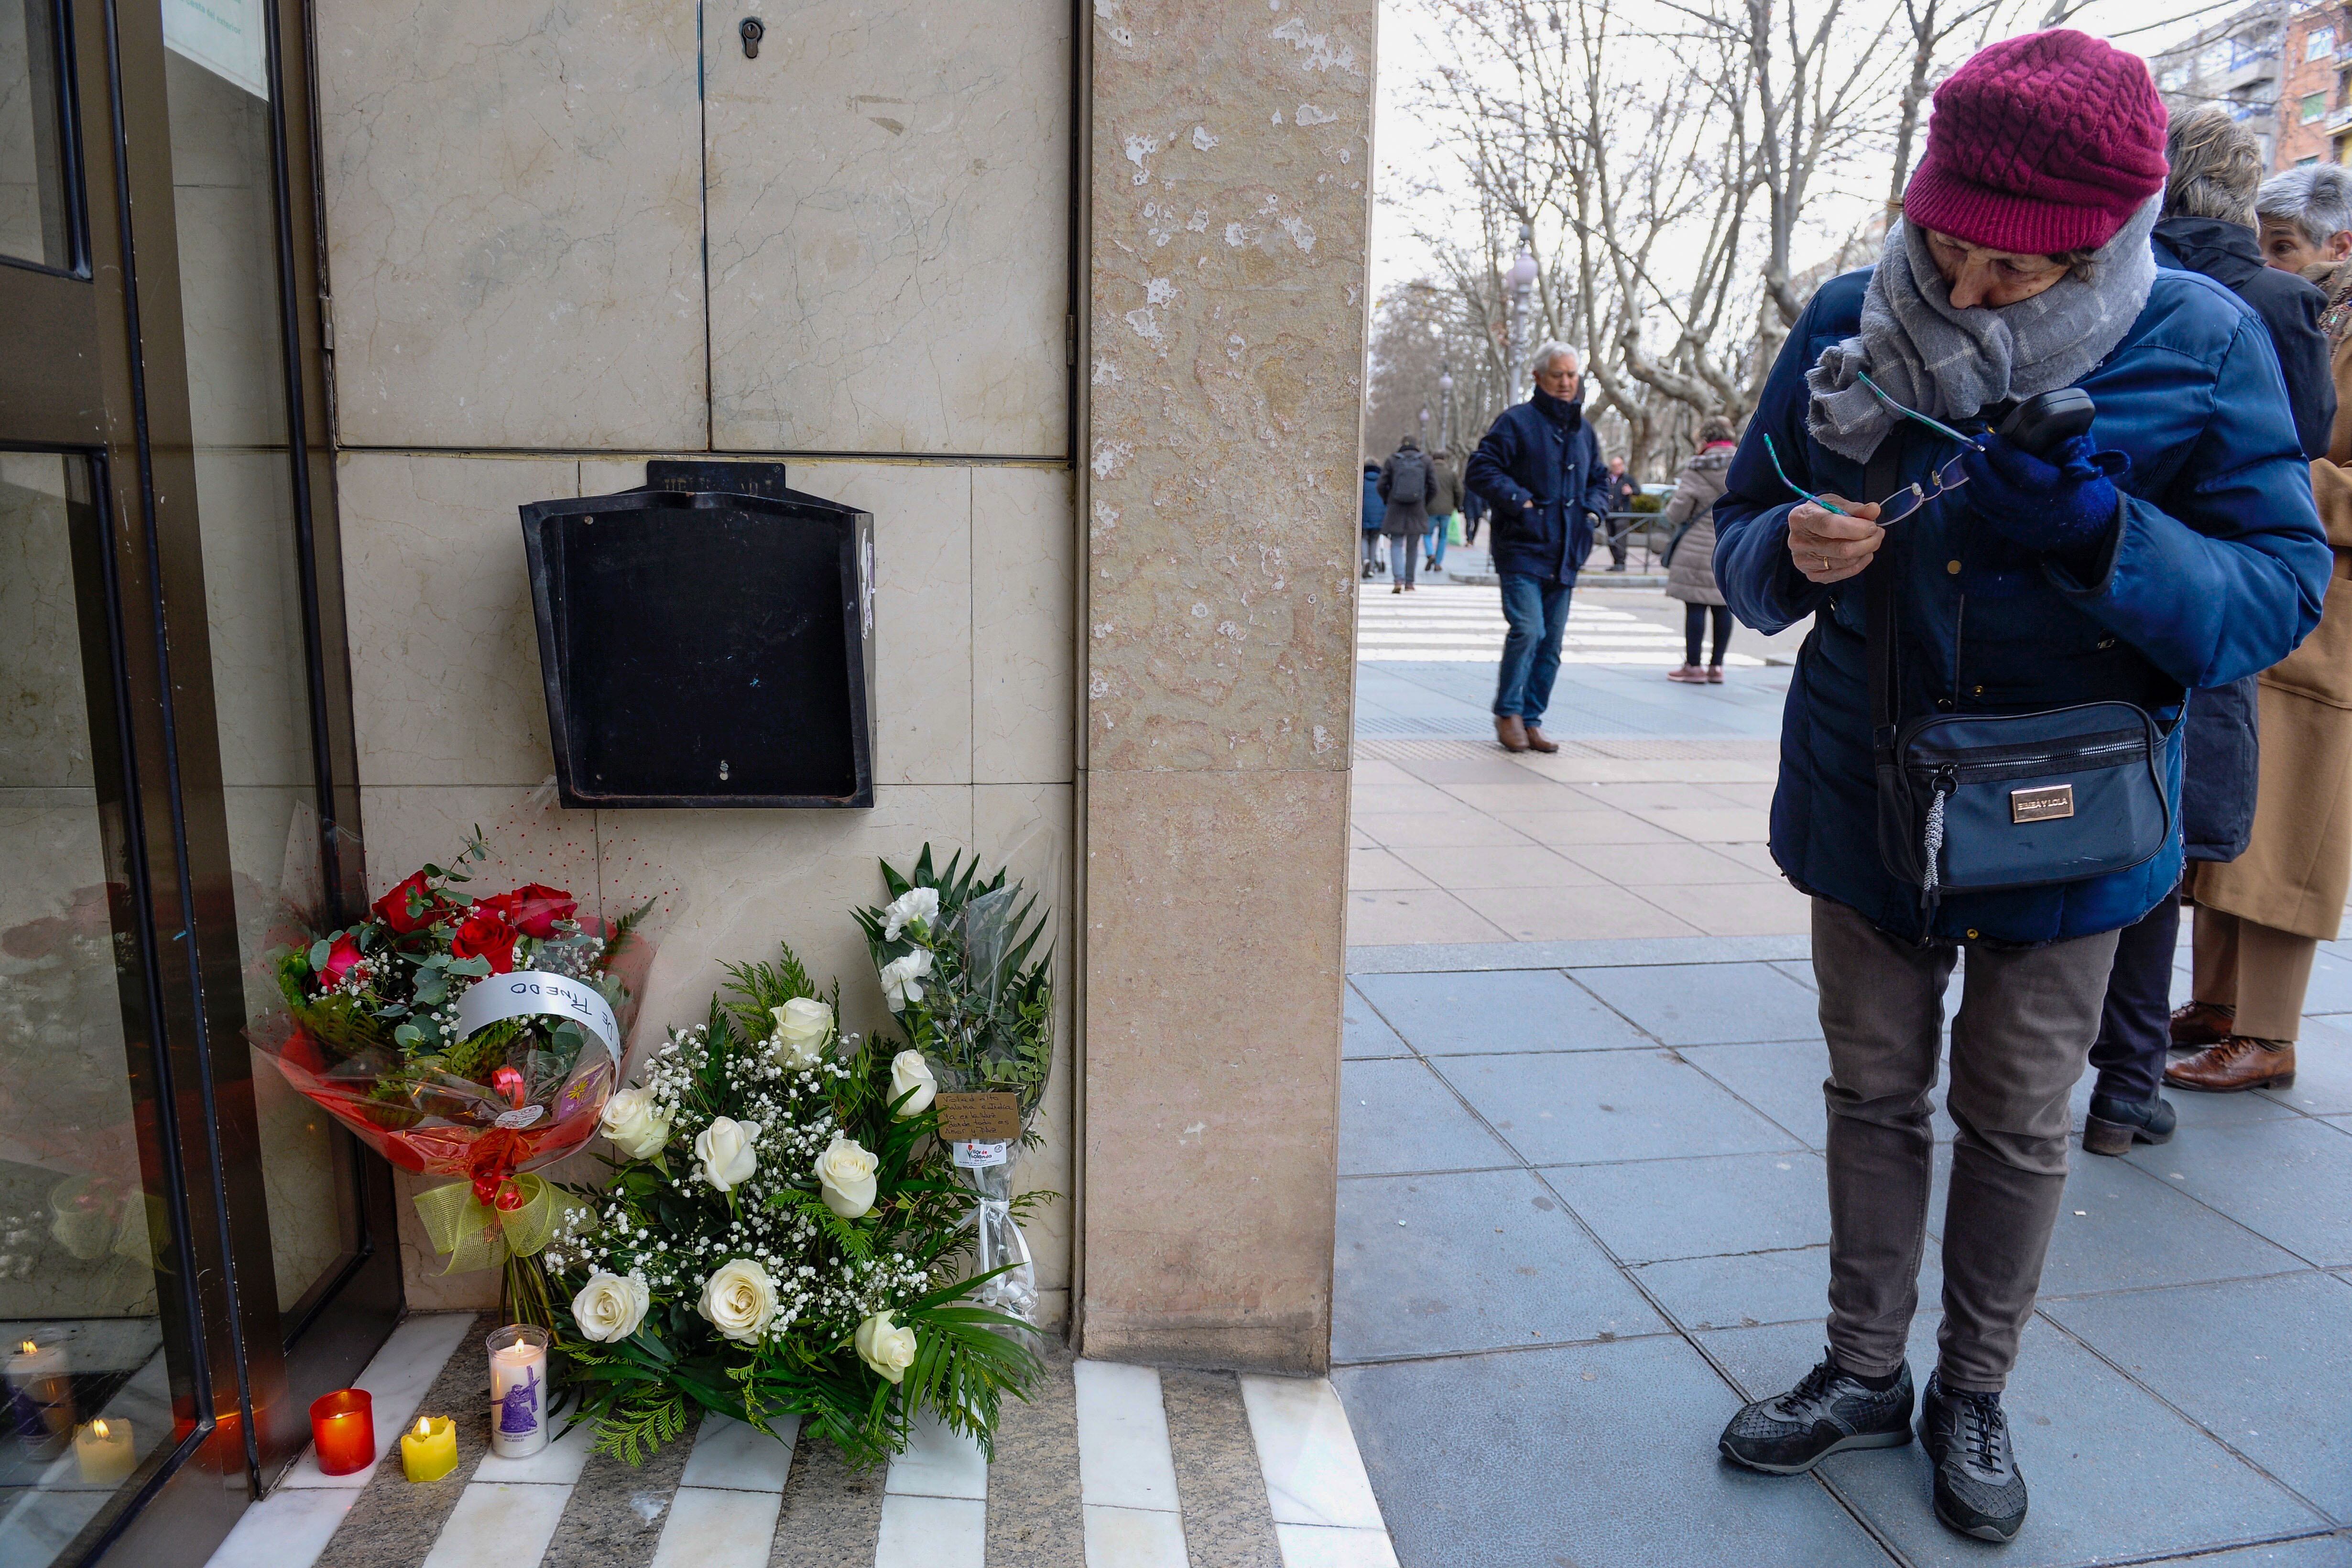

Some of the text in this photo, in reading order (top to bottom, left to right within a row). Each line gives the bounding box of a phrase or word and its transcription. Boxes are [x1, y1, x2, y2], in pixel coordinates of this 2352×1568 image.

[216, 16, 241, 35] exterior
[602, 1011, 613, 1042] DE
[942, 1094, 975, 1102] Volad
[948, 1120, 971, 1128] donde
[971, 1129, 976, 1137] y
